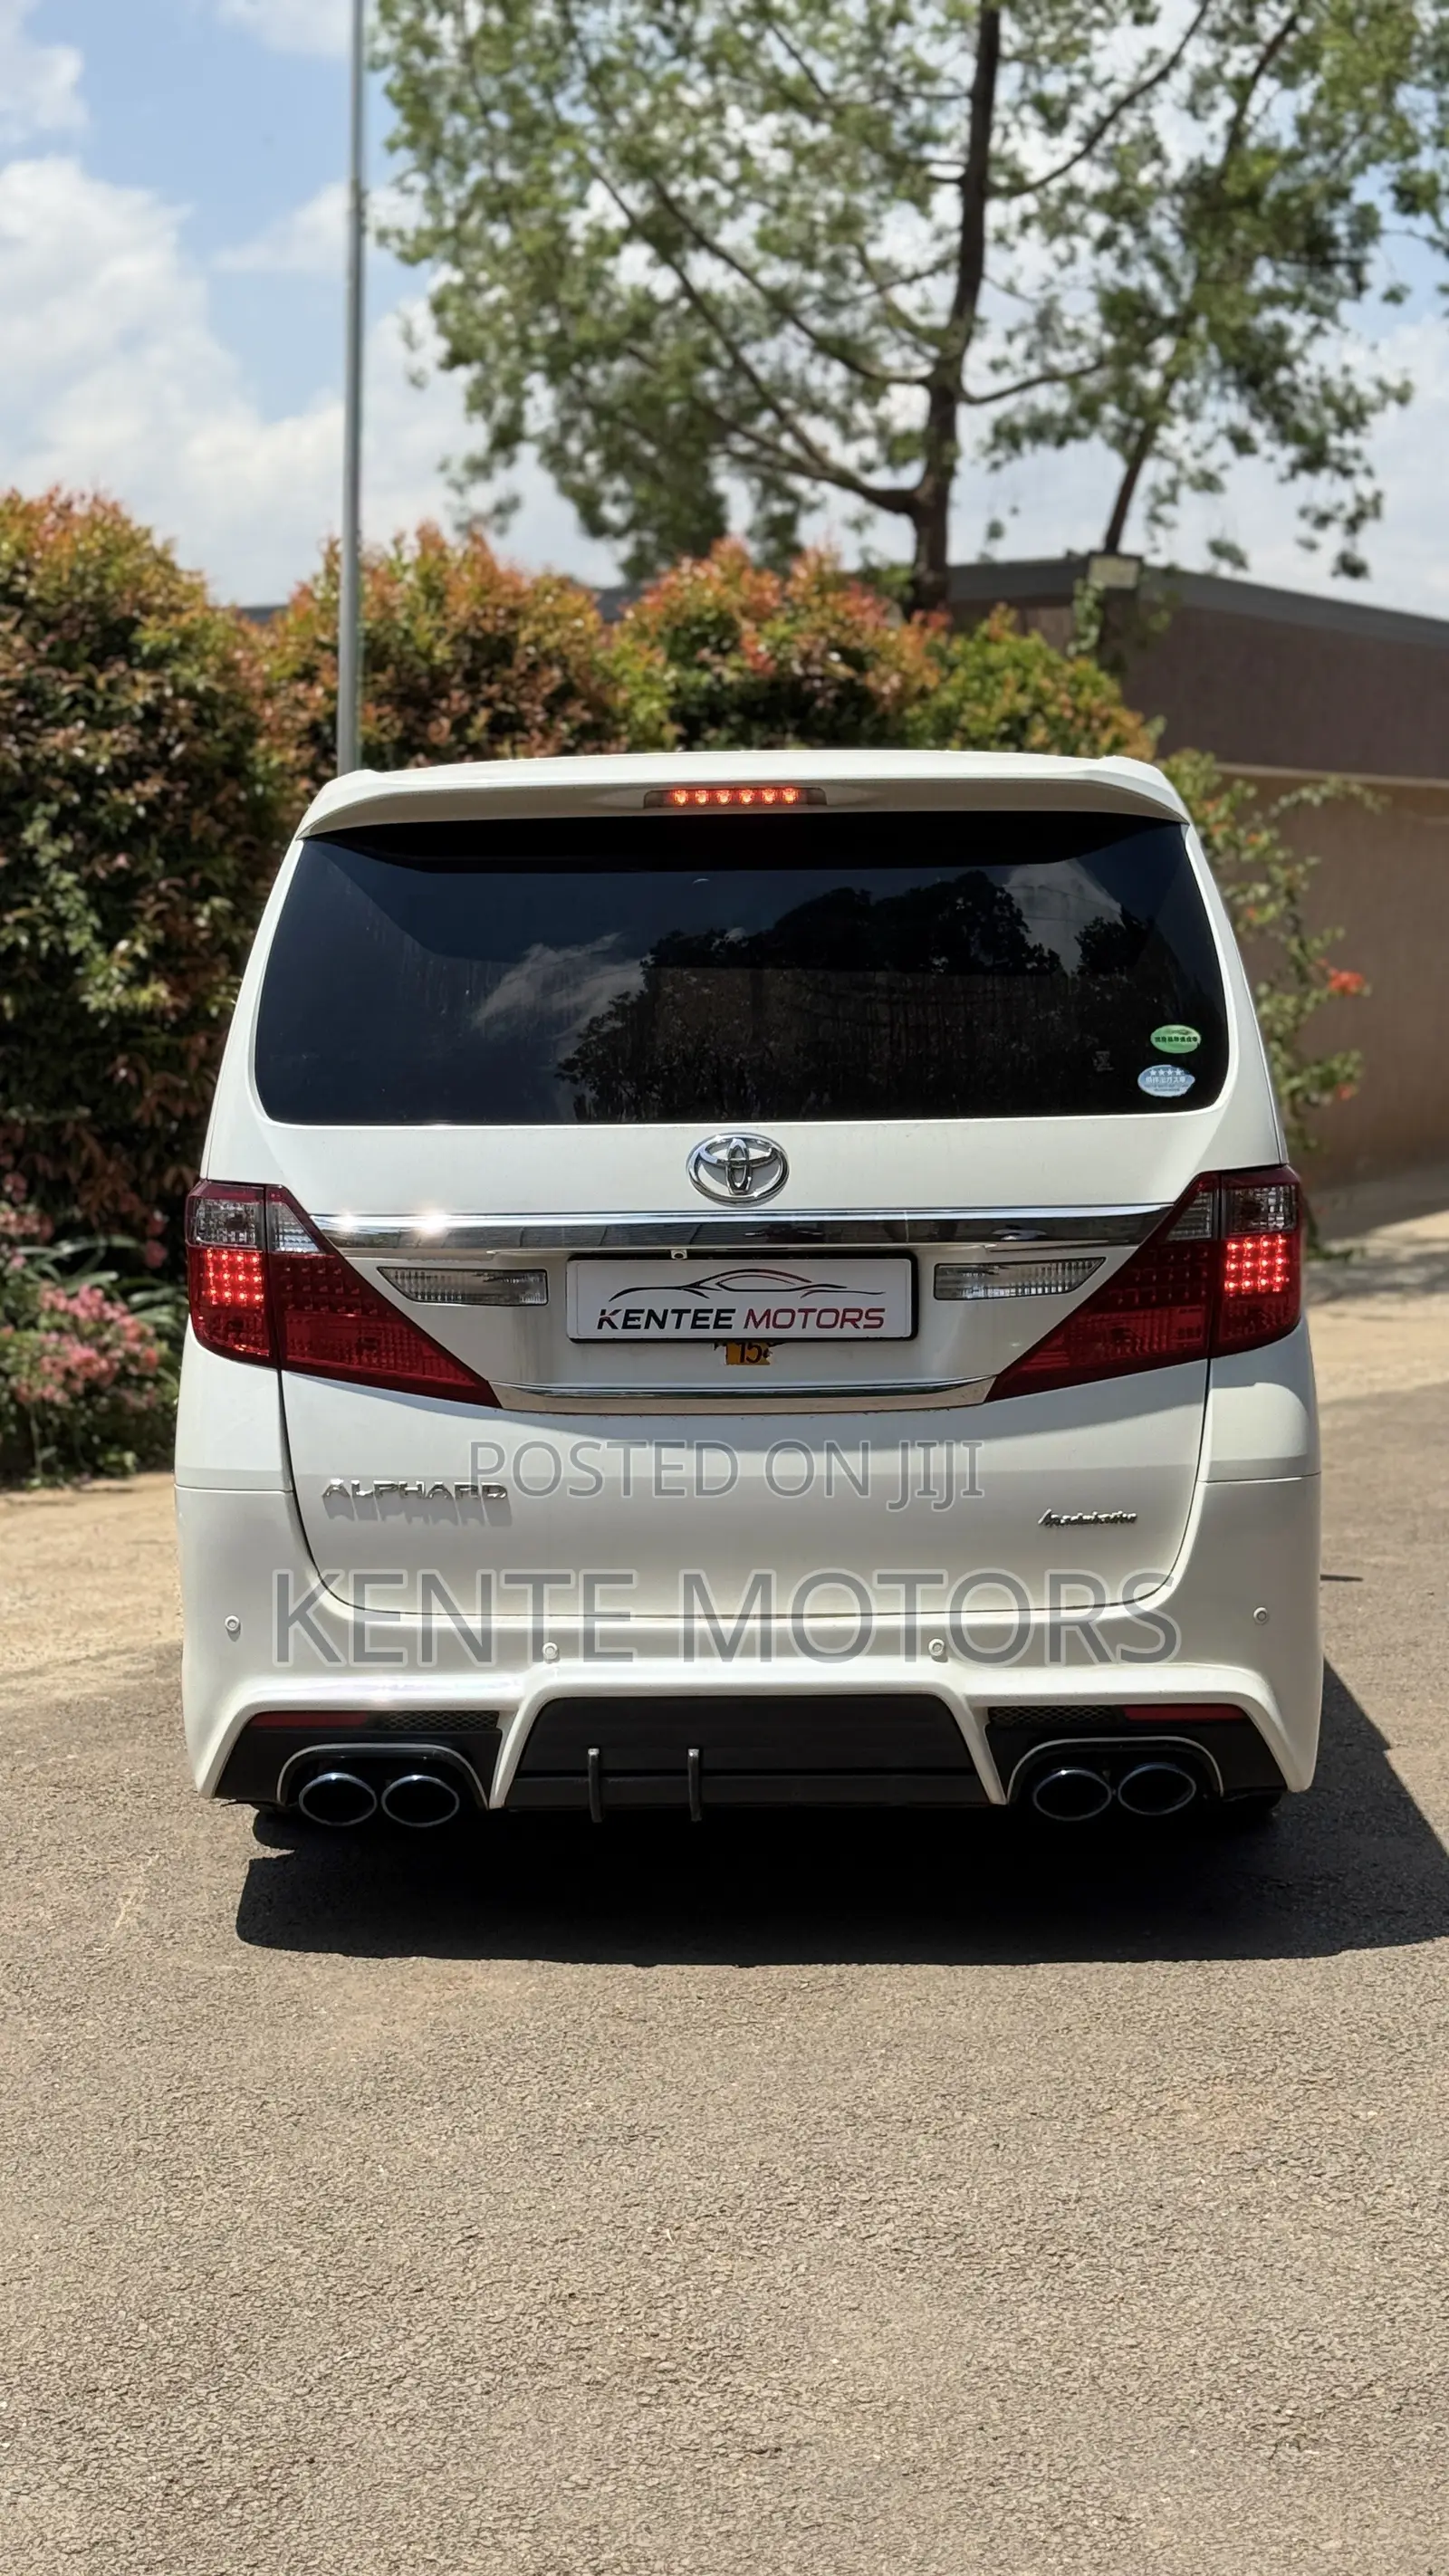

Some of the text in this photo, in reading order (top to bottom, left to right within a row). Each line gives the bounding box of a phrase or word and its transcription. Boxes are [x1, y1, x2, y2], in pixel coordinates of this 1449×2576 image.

[597, 1307, 887, 1330] KENTEE MOTORS
[321, 1479, 509, 1500] ALPHARD
